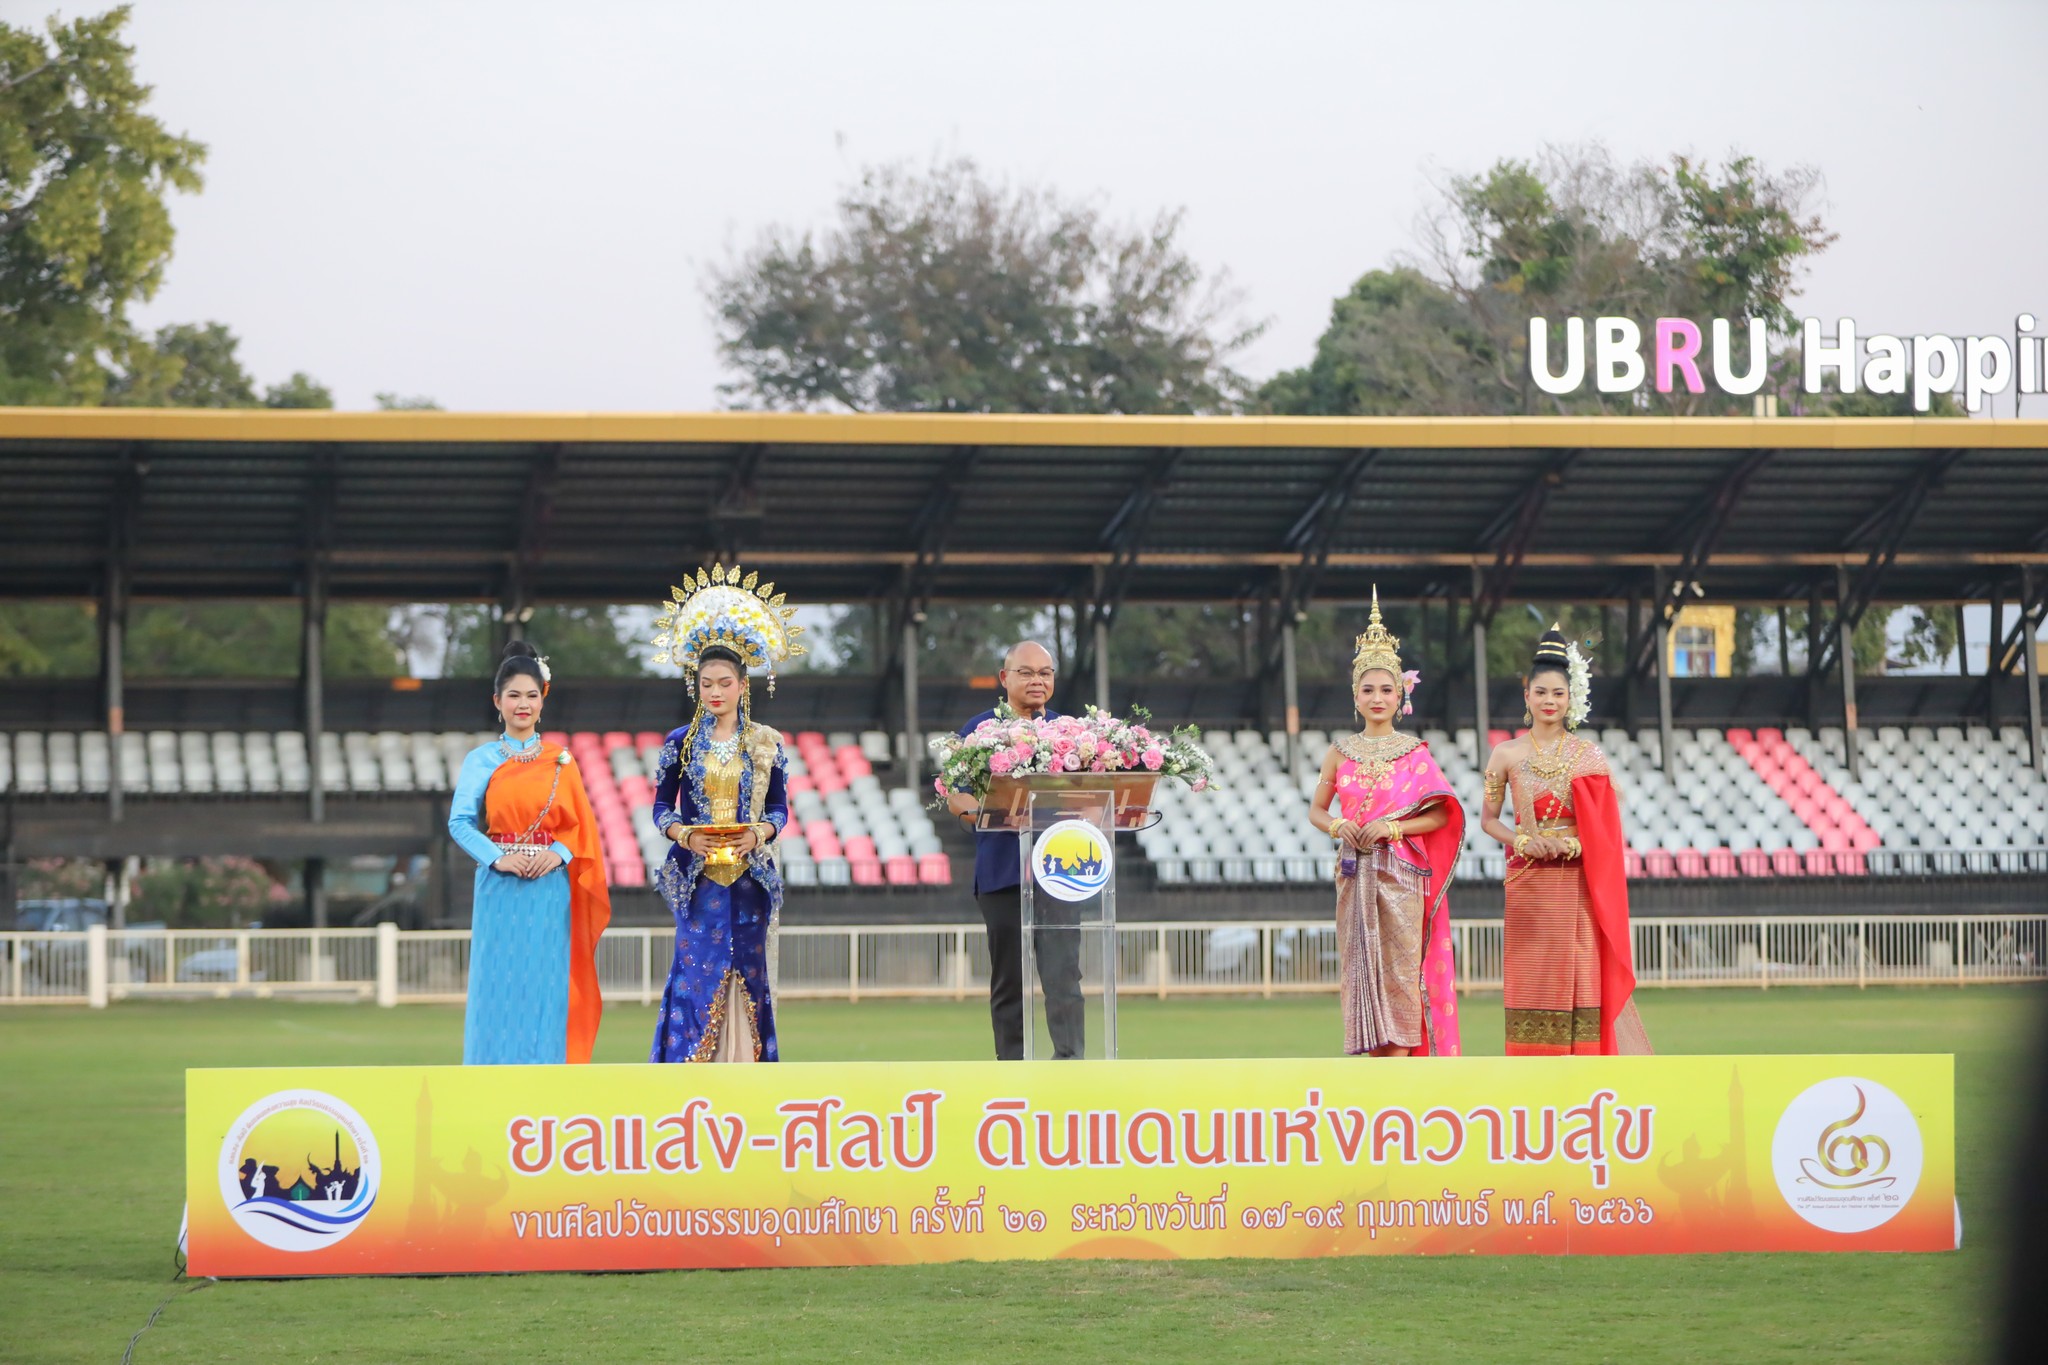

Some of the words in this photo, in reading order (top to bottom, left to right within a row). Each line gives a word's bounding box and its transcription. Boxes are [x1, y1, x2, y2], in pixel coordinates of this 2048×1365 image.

[1529, 317, 1768, 395] UBRU
[1803, 313, 2048, 412] Happi
[509, 1091, 943, 1174] ยลแสง-ศิลป์
[976, 1090, 1653, 1187] ดินแดนแห่งความสุข
[511, 1197, 898, 1247] งานศิลปวัฒนธรรมอุดมศึกษา
[910, 1186, 985, 1234] ครั้งที่
[998, 1204, 1047, 1233] ๒๑
[1072, 1182, 1228, 1232] ระหว่างวันที่
[1241, 1201, 1344, 1229] ๑๗-๑๙
[1357, 1189, 1495, 1240] กุมภาพันธ์
[1503, 1191, 1557, 1225] พ.ศ.
[1570, 1198, 1654, 1225] ๒๕๖๖
